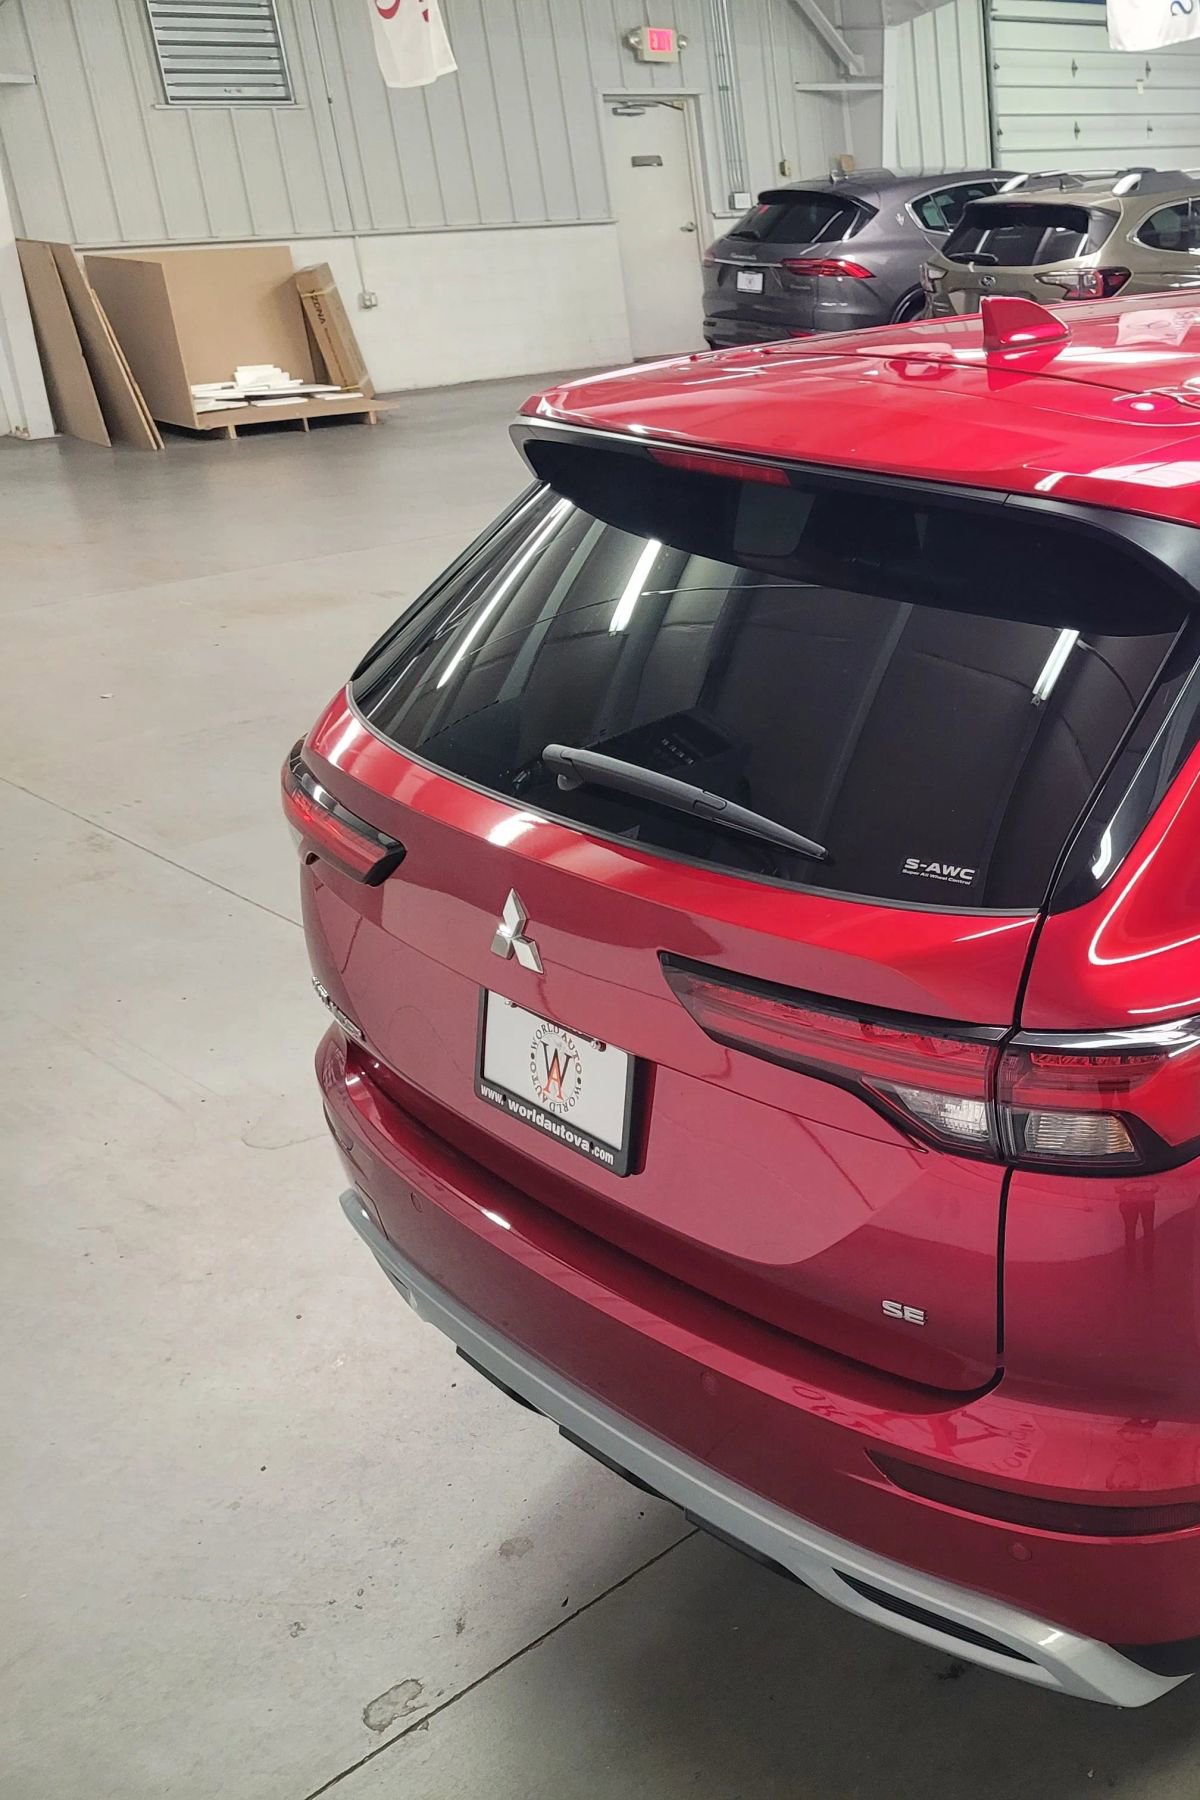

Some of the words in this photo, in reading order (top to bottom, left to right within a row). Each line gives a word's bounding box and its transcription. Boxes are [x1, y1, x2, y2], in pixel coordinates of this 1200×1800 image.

[904, 858, 976, 880] S-AWC
[530, 1022, 560, 1050] WORLD
[561, 1033, 582, 1075] AUTO
[882, 1300, 925, 1326] SE
